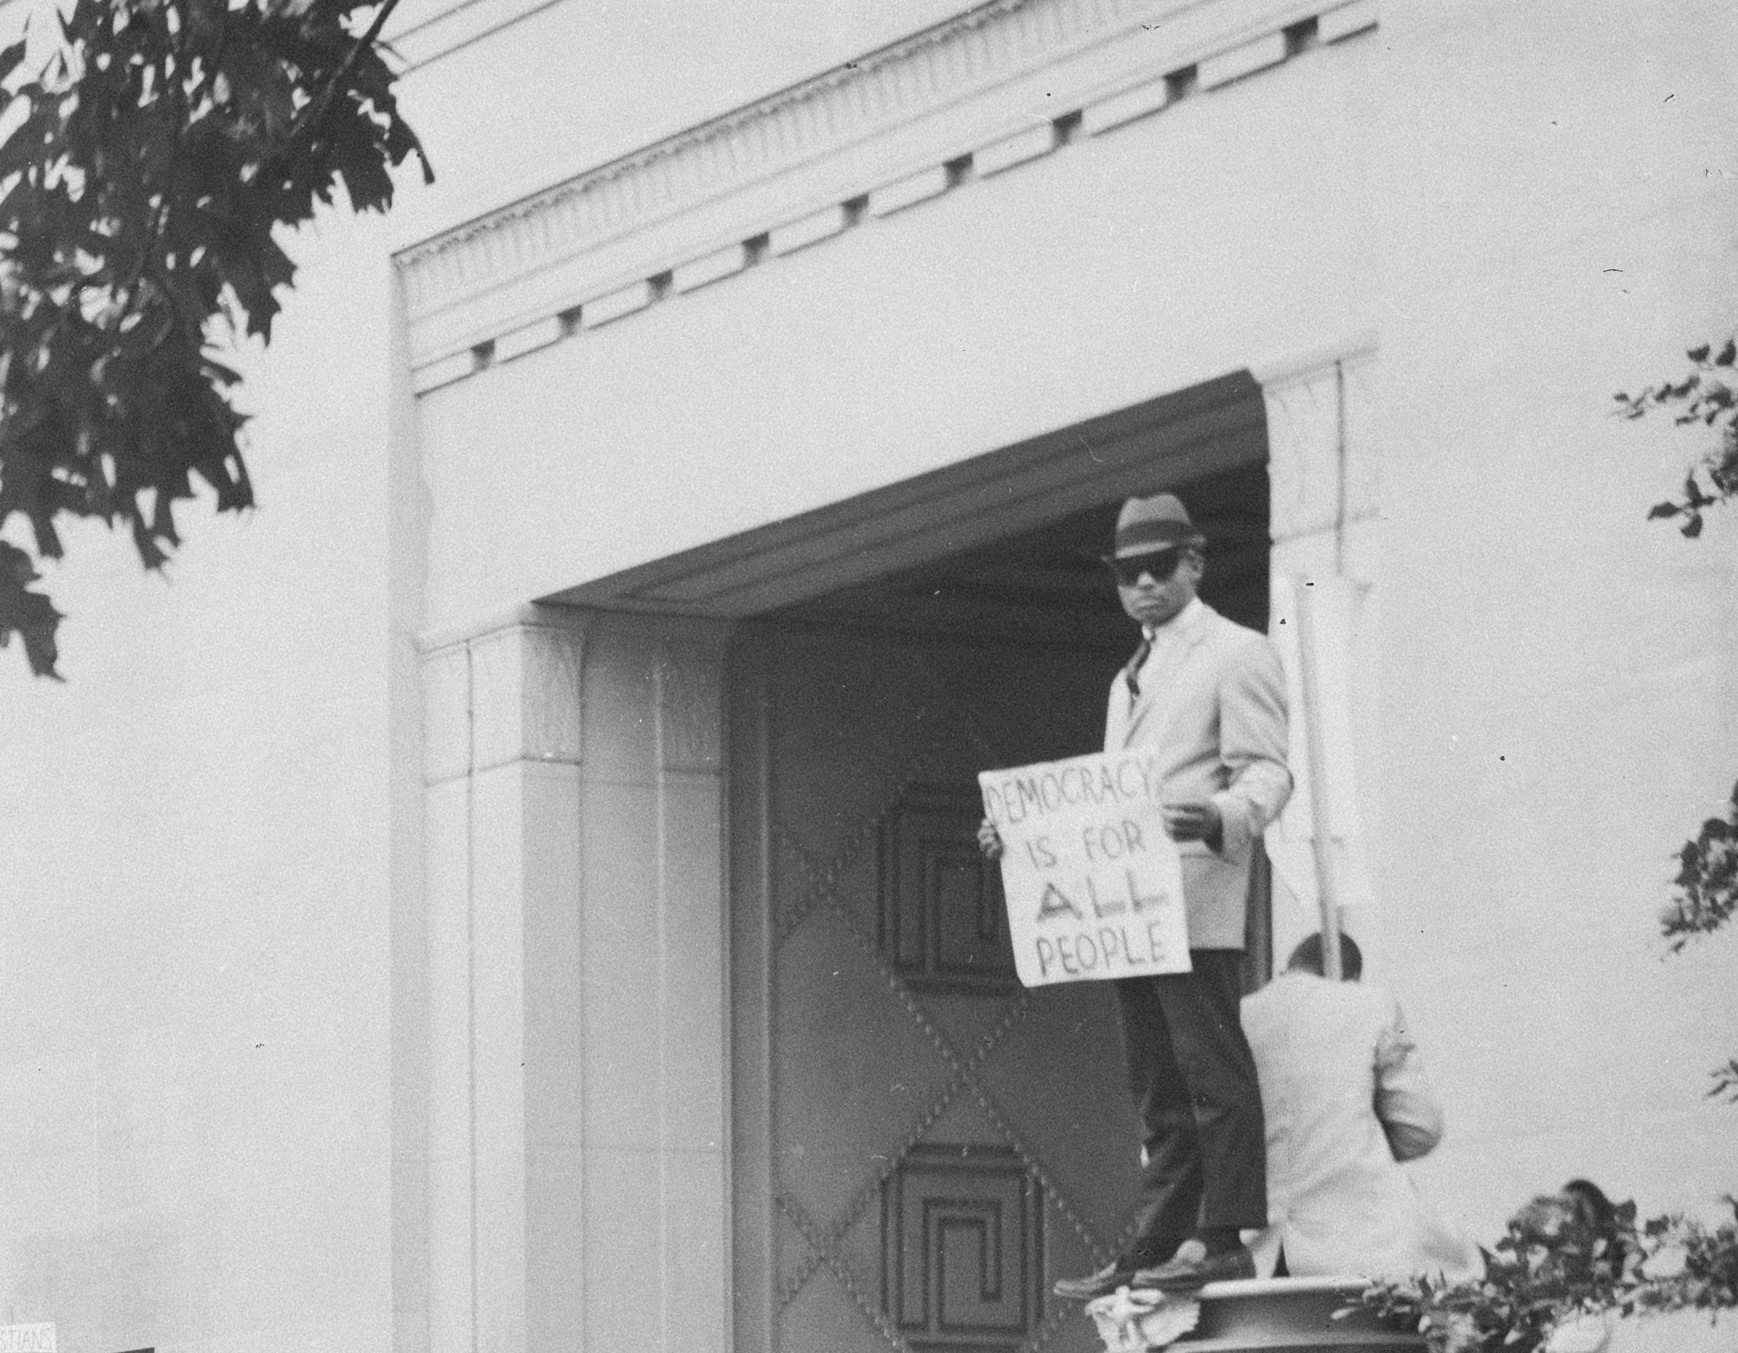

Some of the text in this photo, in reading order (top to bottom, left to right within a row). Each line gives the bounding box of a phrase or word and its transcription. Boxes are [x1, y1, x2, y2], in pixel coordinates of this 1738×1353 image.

[984, 756, 1153, 824] DEMOCRACY
[1026, 820, 1147, 868] IS FOR
[1036, 869, 1169, 923] ALL
[1036, 920, 1165, 978] PEOPLE
